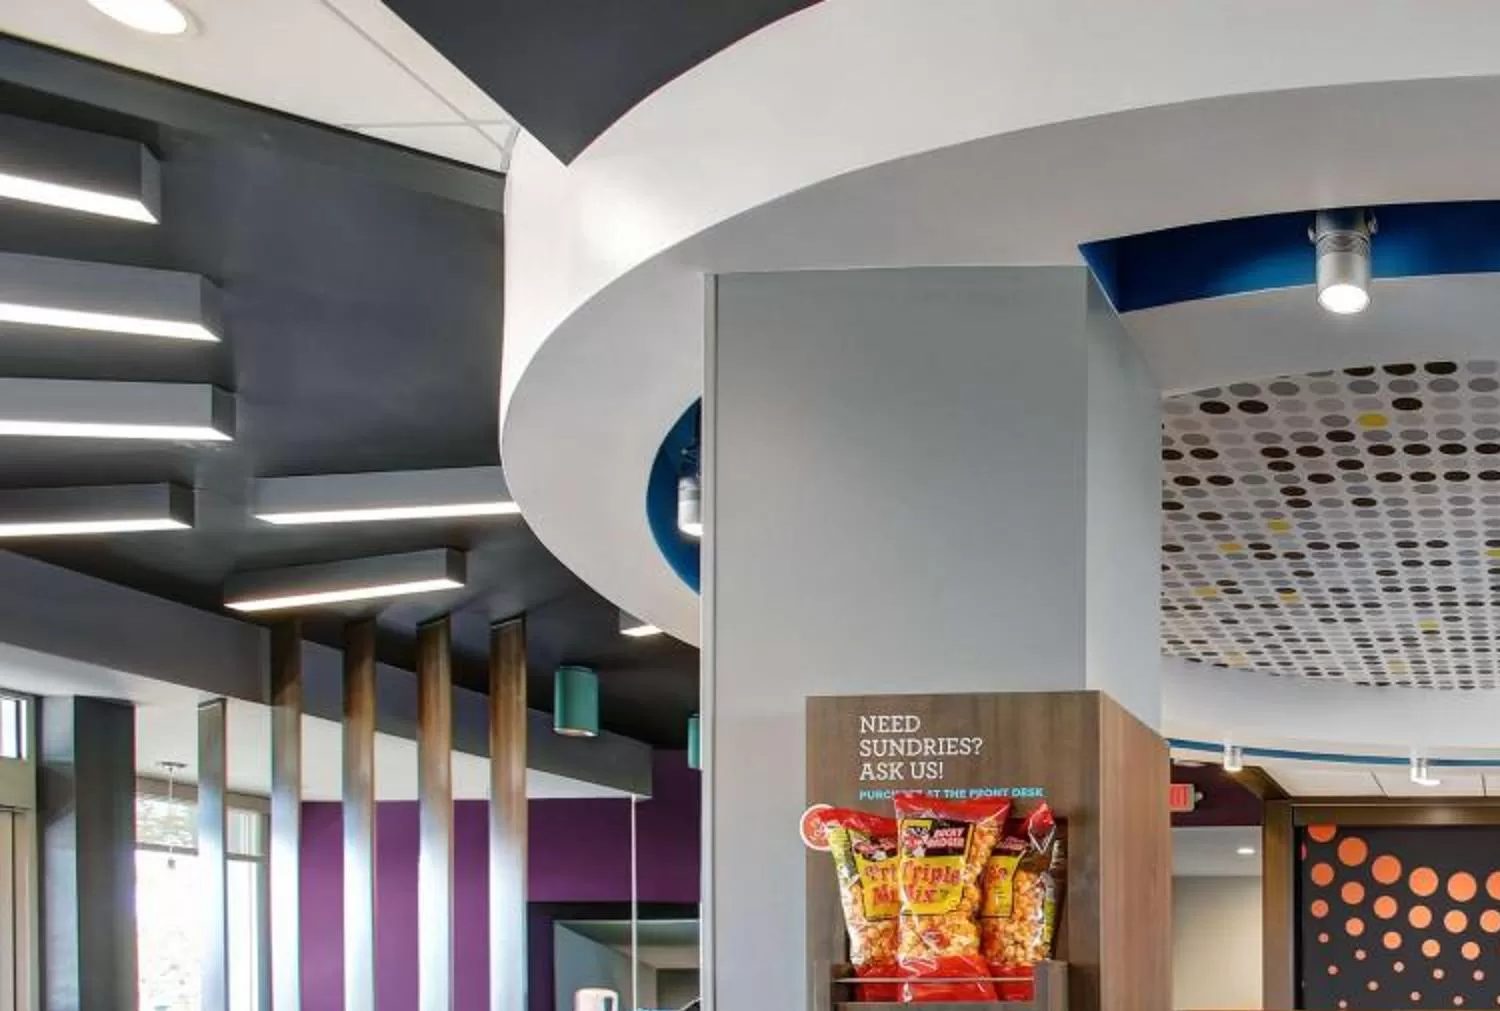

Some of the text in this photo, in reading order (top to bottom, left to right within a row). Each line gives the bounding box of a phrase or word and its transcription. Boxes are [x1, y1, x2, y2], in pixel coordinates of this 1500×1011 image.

[859, 715, 920, 733] NEED
[859, 738, 983, 758] SUNDRIES?
[859, 761, 944, 782] ASK US!
[939, 788, 967, 798] THE
[969, 787, 1009, 798] FRONT
[1011, 787, 1043, 797] DESK
